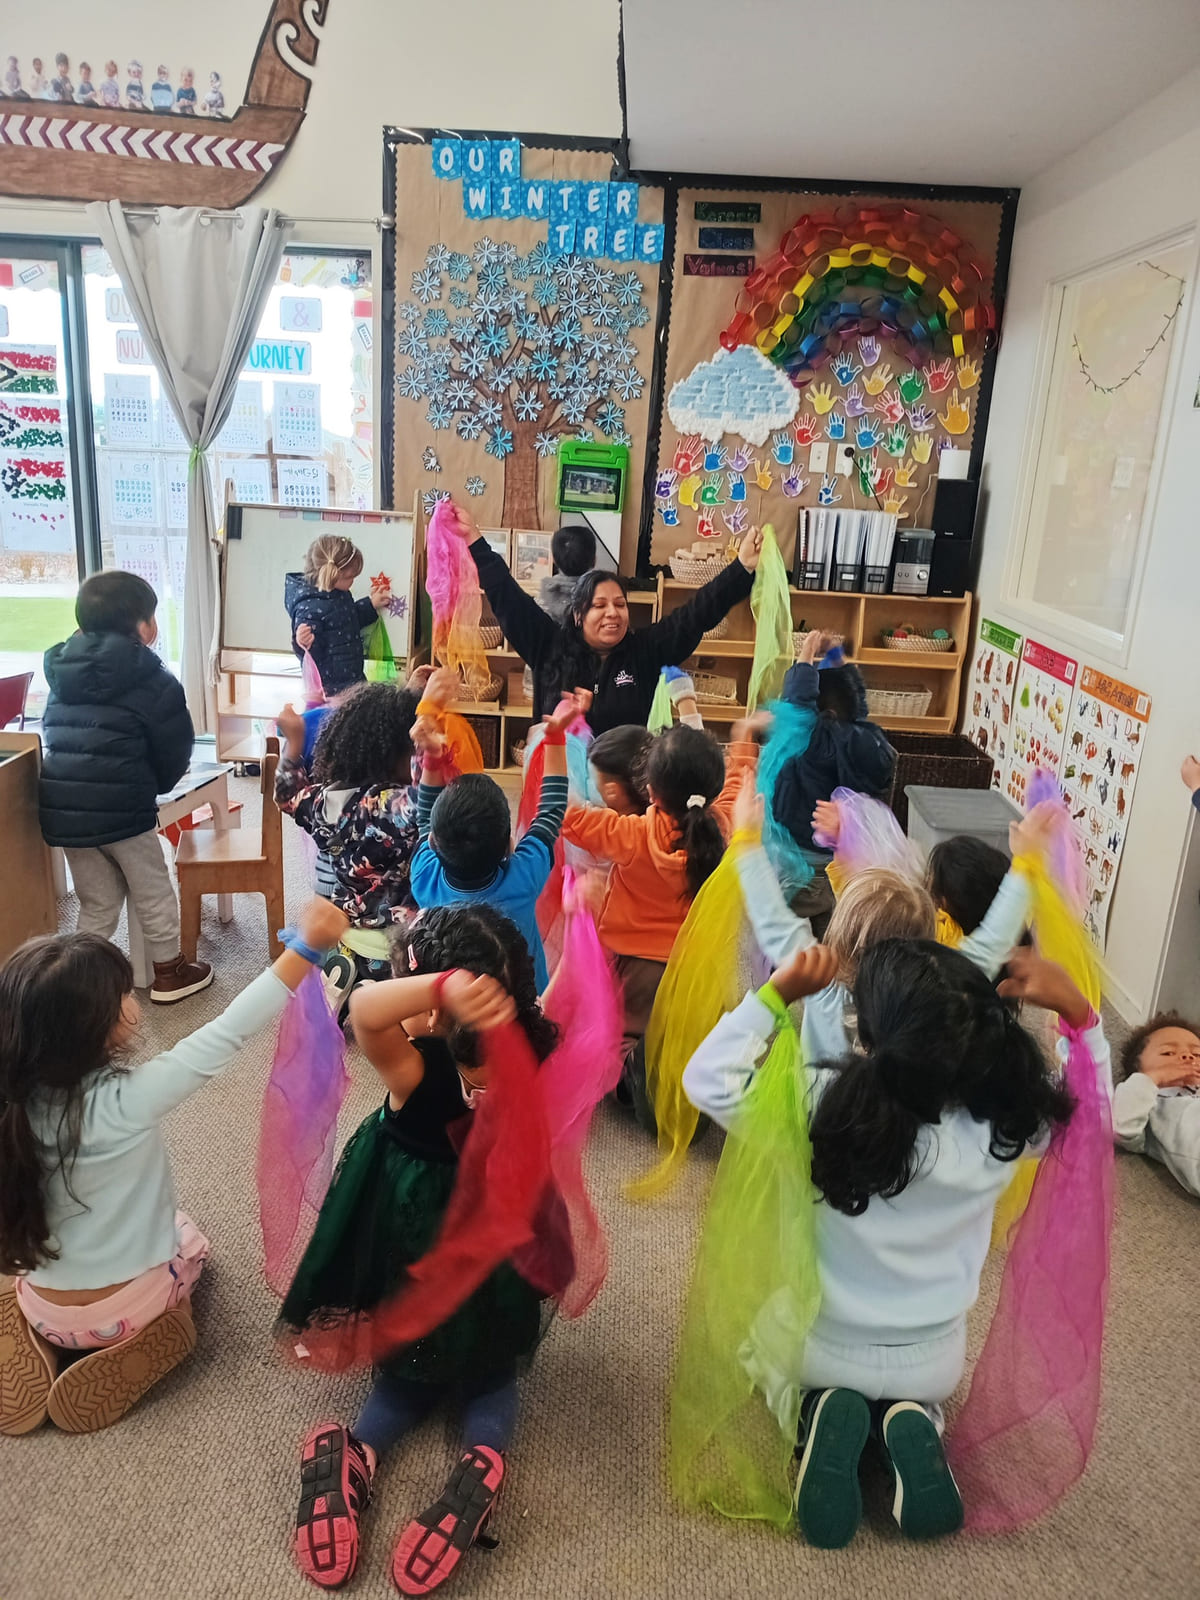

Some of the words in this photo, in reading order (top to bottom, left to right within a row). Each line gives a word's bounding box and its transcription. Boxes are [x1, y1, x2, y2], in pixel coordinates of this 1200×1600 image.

[439, 147, 514, 173] OUR
[469, 186, 632, 215] WINTER
[555, 225, 656, 254] TREE
[110, 292, 132, 317] OU
[293, 302, 310, 327] &
[119, 336, 145, 360] NU
[249, 344, 305, 371] URNEY
[1106, 709, 1113, 726] C
[1124, 718, 1132, 736] D
